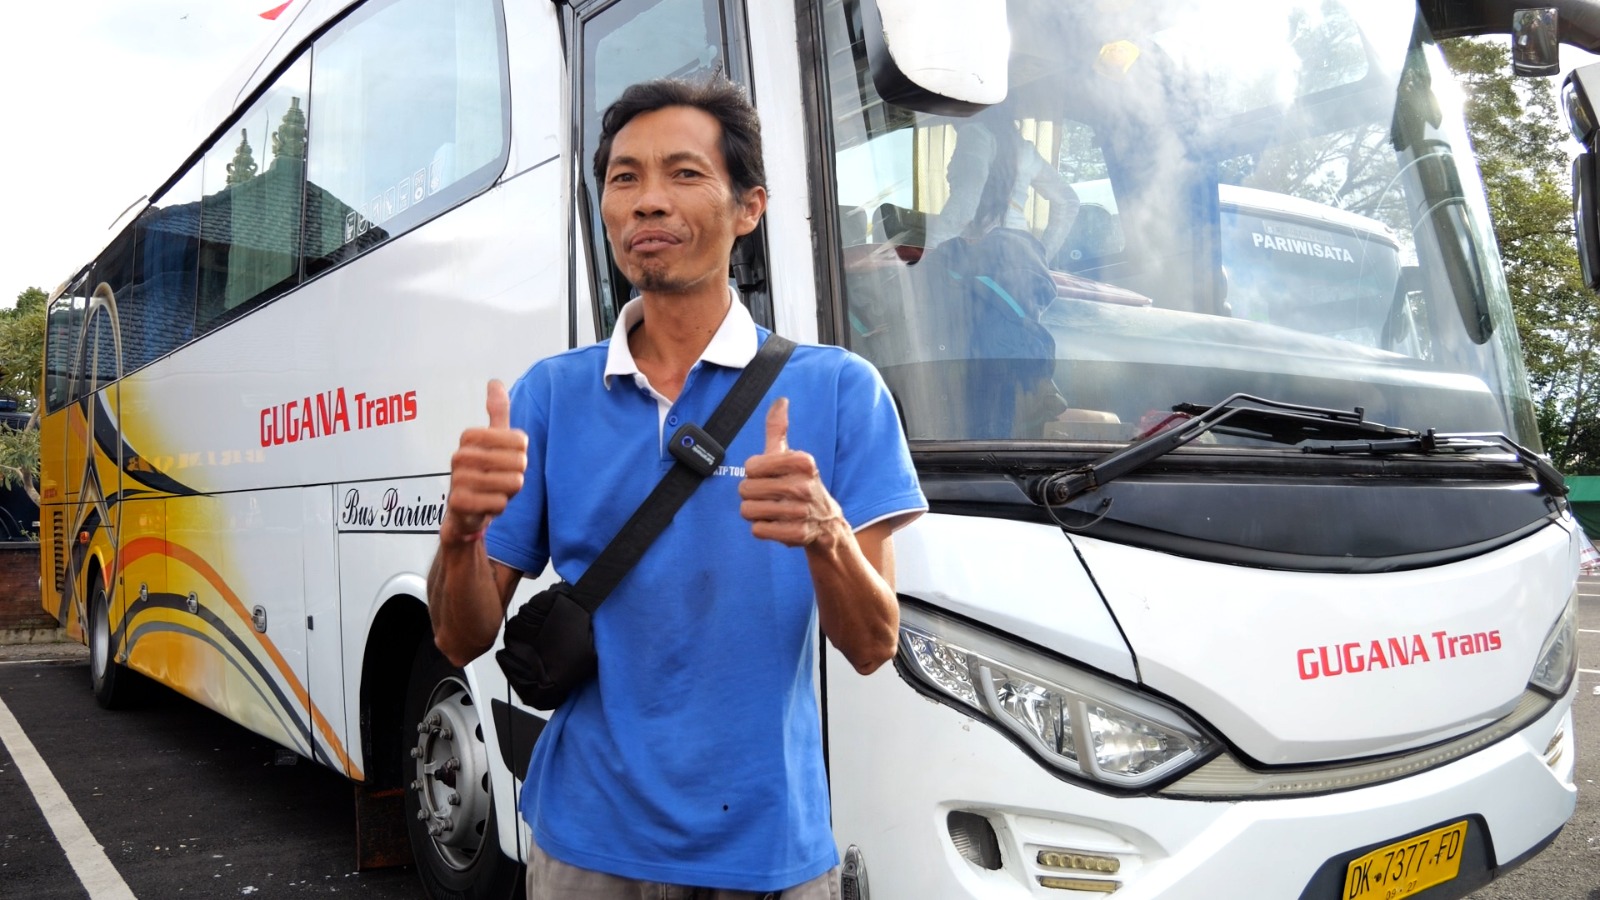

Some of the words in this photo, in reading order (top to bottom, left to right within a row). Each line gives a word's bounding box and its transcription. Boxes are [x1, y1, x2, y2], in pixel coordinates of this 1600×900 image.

[1252, 232, 1354, 263] PARIWISATA
[260, 387, 350, 448] GUGANA
[354, 390, 417, 430] Trans
[729, 466, 748, 478] TOU
[342, 488, 378, 526] Bus
[1296, 634, 1430, 680] GUGANA
[1432, 630, 1502, 660] Trans
[1349, 860, 1374, 900] DK
[1382, 840, 1430, 886] 7377
[1435, 829, 1460, 865] FD
